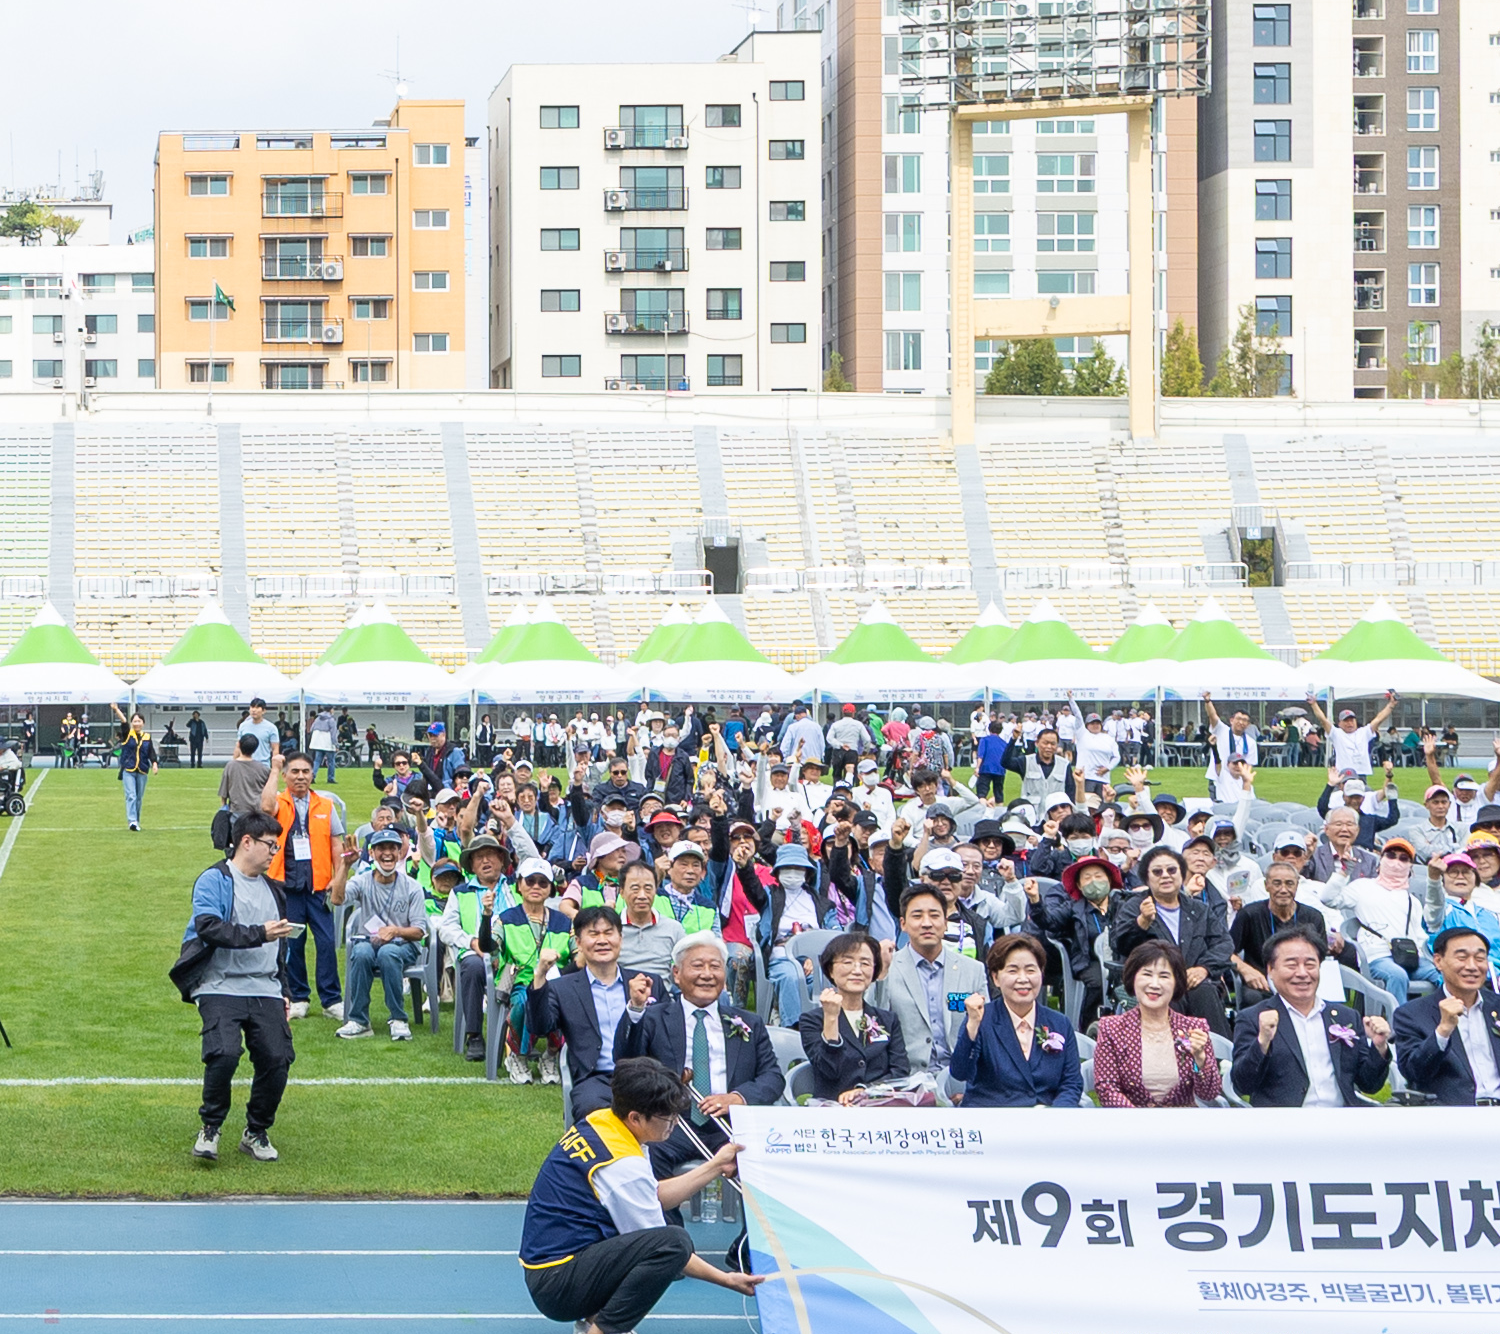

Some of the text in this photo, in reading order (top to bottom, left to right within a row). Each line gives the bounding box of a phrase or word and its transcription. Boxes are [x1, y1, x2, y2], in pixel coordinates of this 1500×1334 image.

[557, 1124, 597, 1164] TAFF
[792, 1127, 984, 1149] 사단 한국지체장애인협회
[793, 1142, 818, 1154] 법인
[764, 1147, 792, 1155] KAPPD
[952, 1149, 984, 1157] Disabilities
[967, 1181, 1134, 1247] 제9회
[1197, 1281, 1318, 1304] 휠체어경주,
[1321, 1282, 1442, 1305] 빅볼굴리기,
